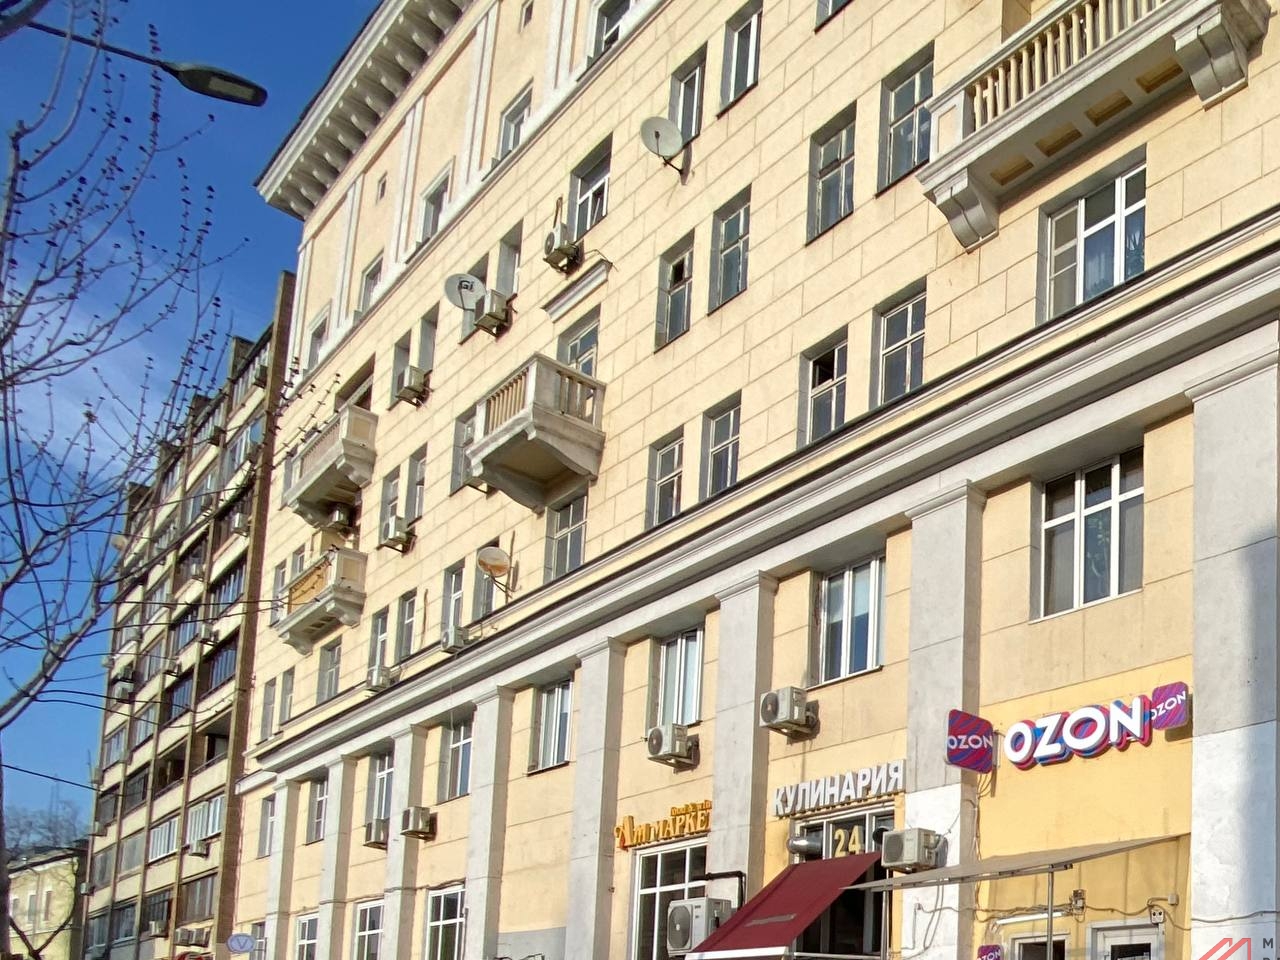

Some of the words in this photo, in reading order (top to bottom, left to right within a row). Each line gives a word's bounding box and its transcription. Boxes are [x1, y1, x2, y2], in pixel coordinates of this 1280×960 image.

[1150, 691, 1187, 721] OZON
[947, 735, 993, 750] OZON
[1003, 696, 1143, 764] OZON
[774, 759, 905, 817] КУЛИНАРИЯ
[834, 824, 862, 858] 24
